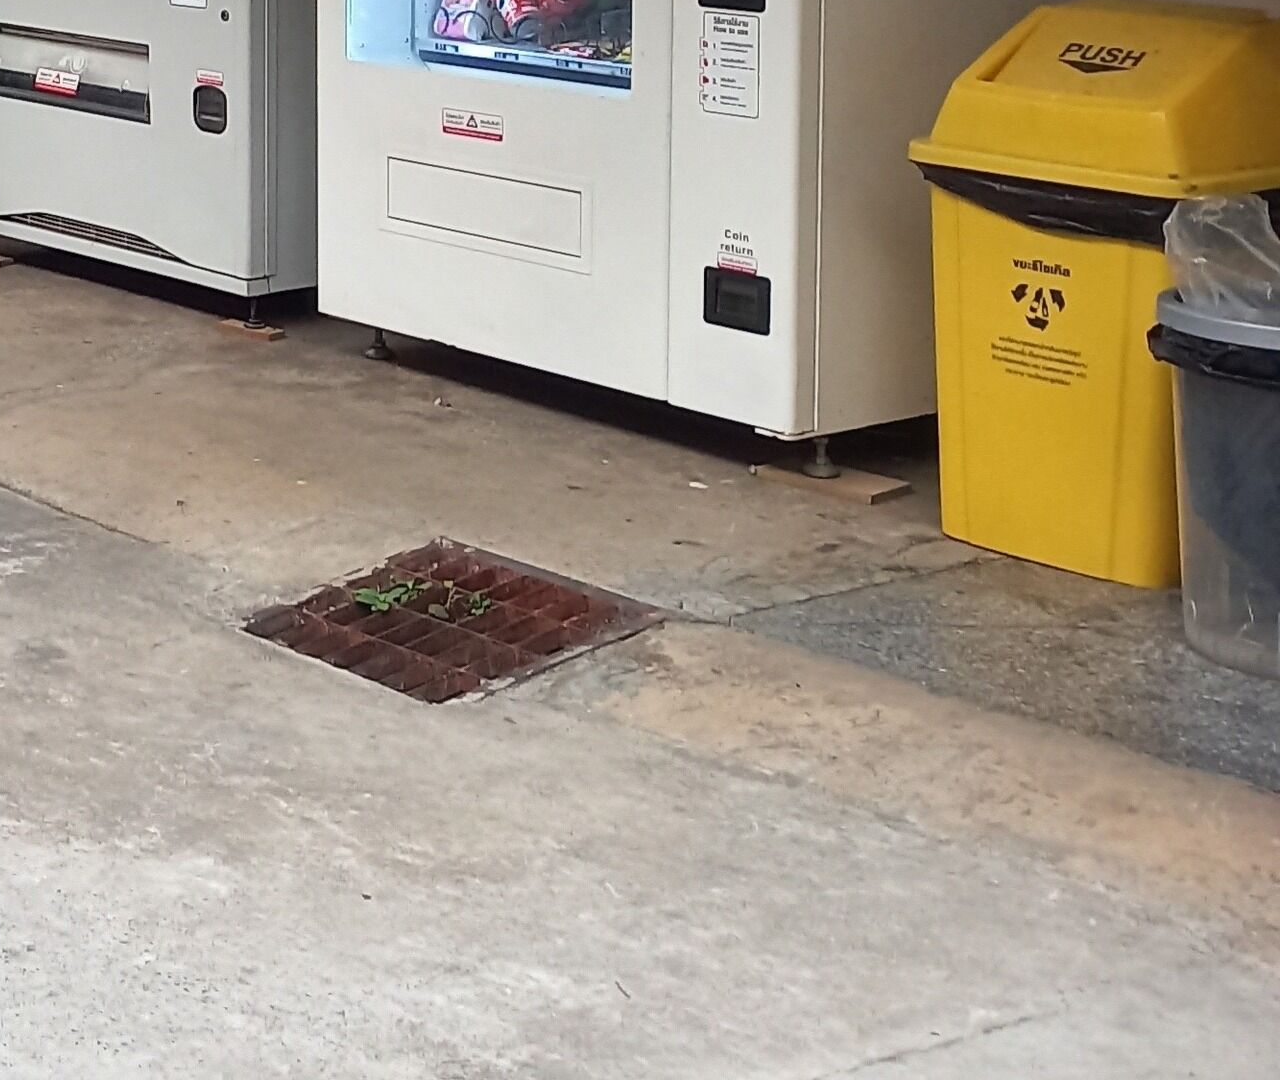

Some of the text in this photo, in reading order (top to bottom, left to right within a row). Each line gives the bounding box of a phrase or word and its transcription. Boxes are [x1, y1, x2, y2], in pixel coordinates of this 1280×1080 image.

[1057, 42, 1147, 67] PUSH
[724, 228, 749, 243] Coin
[720, 243, 754, 257] return
